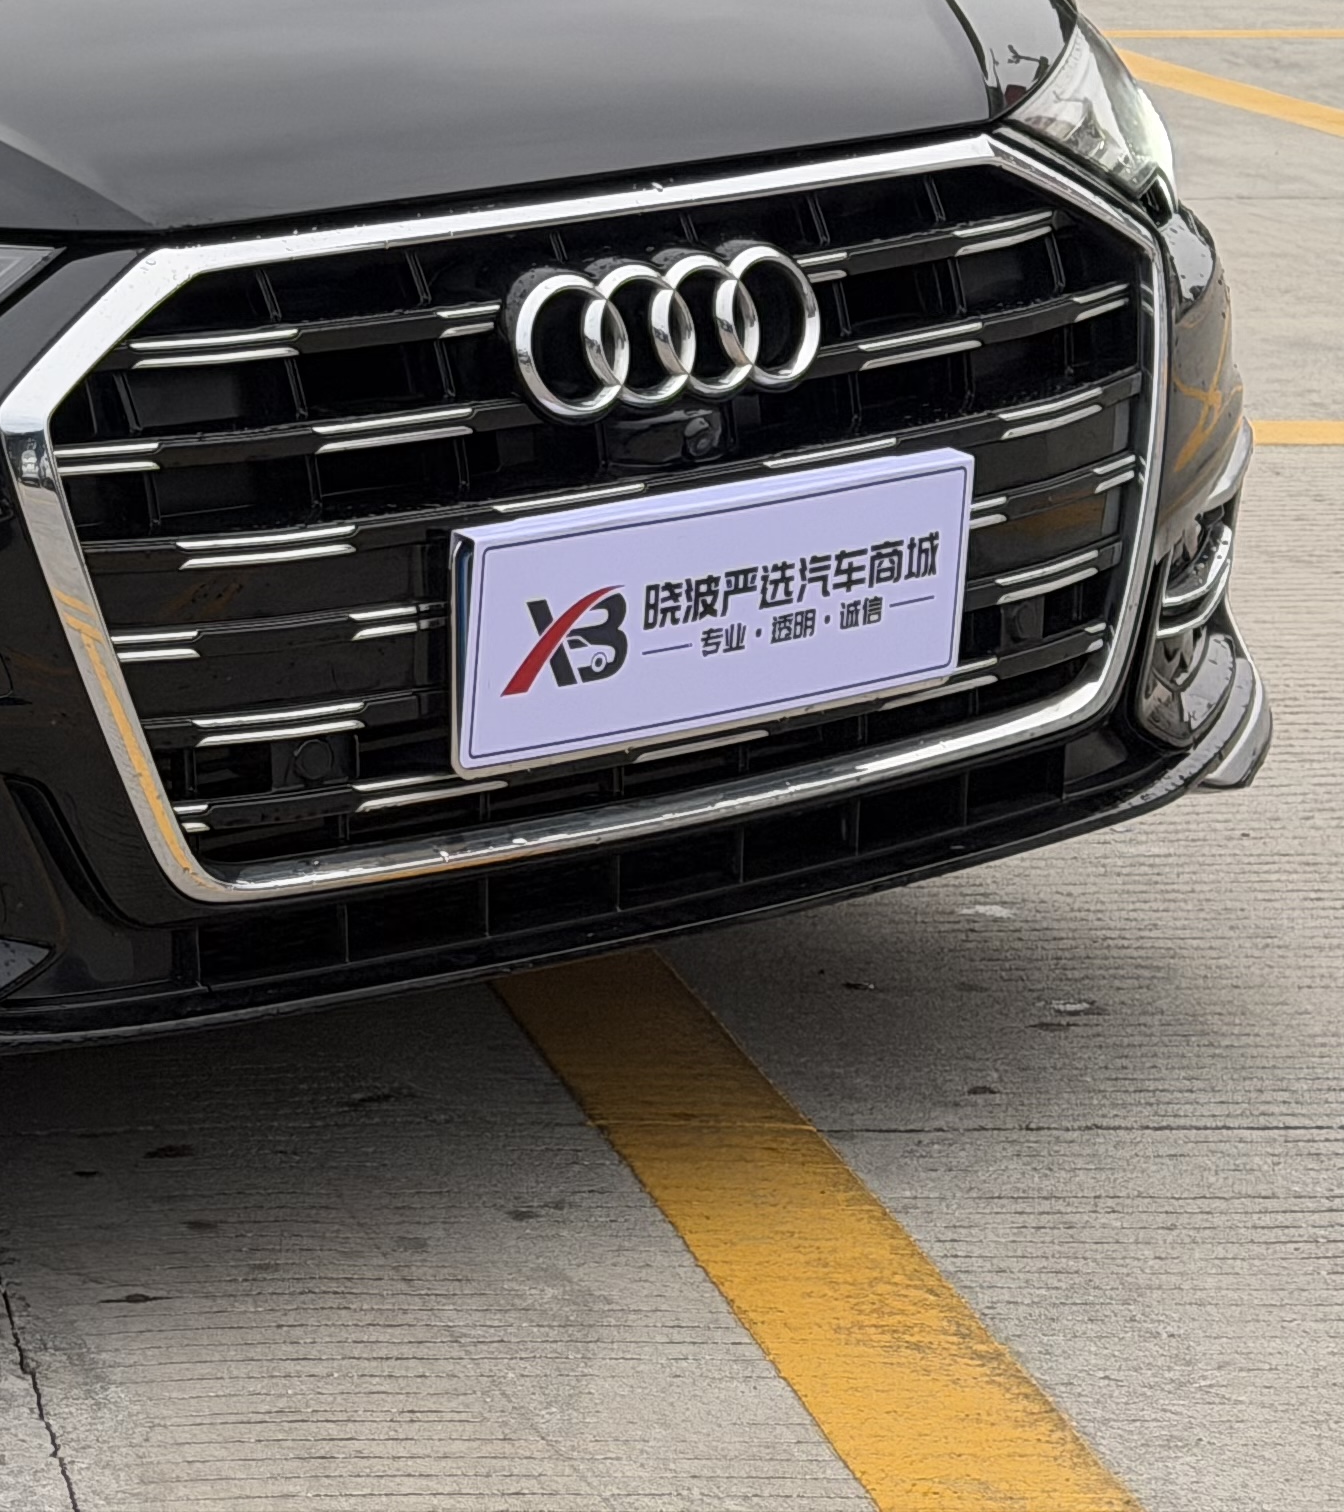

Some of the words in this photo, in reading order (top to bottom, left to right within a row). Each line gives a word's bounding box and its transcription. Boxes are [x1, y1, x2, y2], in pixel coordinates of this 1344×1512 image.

[643, 531, 939, 630] 晓波严选汽车商城
